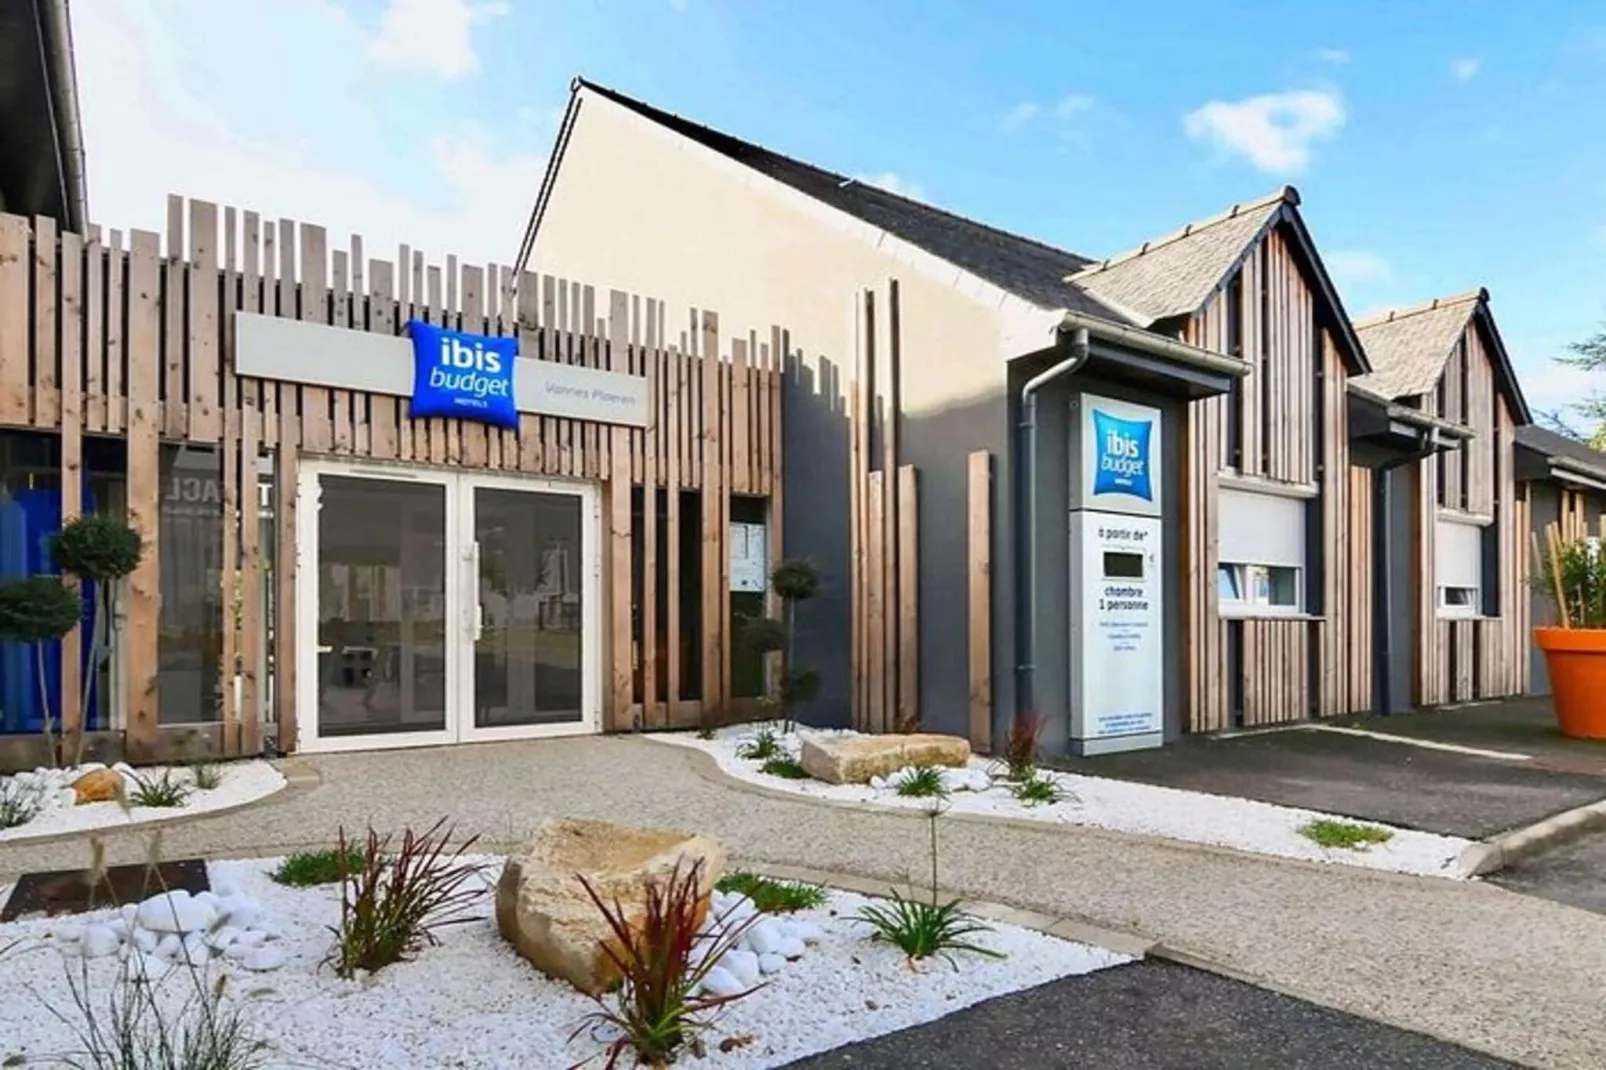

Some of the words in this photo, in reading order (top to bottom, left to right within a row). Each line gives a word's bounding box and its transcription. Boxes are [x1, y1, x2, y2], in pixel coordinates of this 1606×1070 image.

[441, 337, 501, 373] ibis
[430, 366, 509, 398] budget
[1107, 429, 1139, 458] ibis
[1101, 453, 1144, 477] budget
[1106, 528, 1131, 540] partir
[1104, 585, 1143, 597] chambre
[1099, 599, 1104, 610] 1
[1107, 600, 1148, 611] personne
